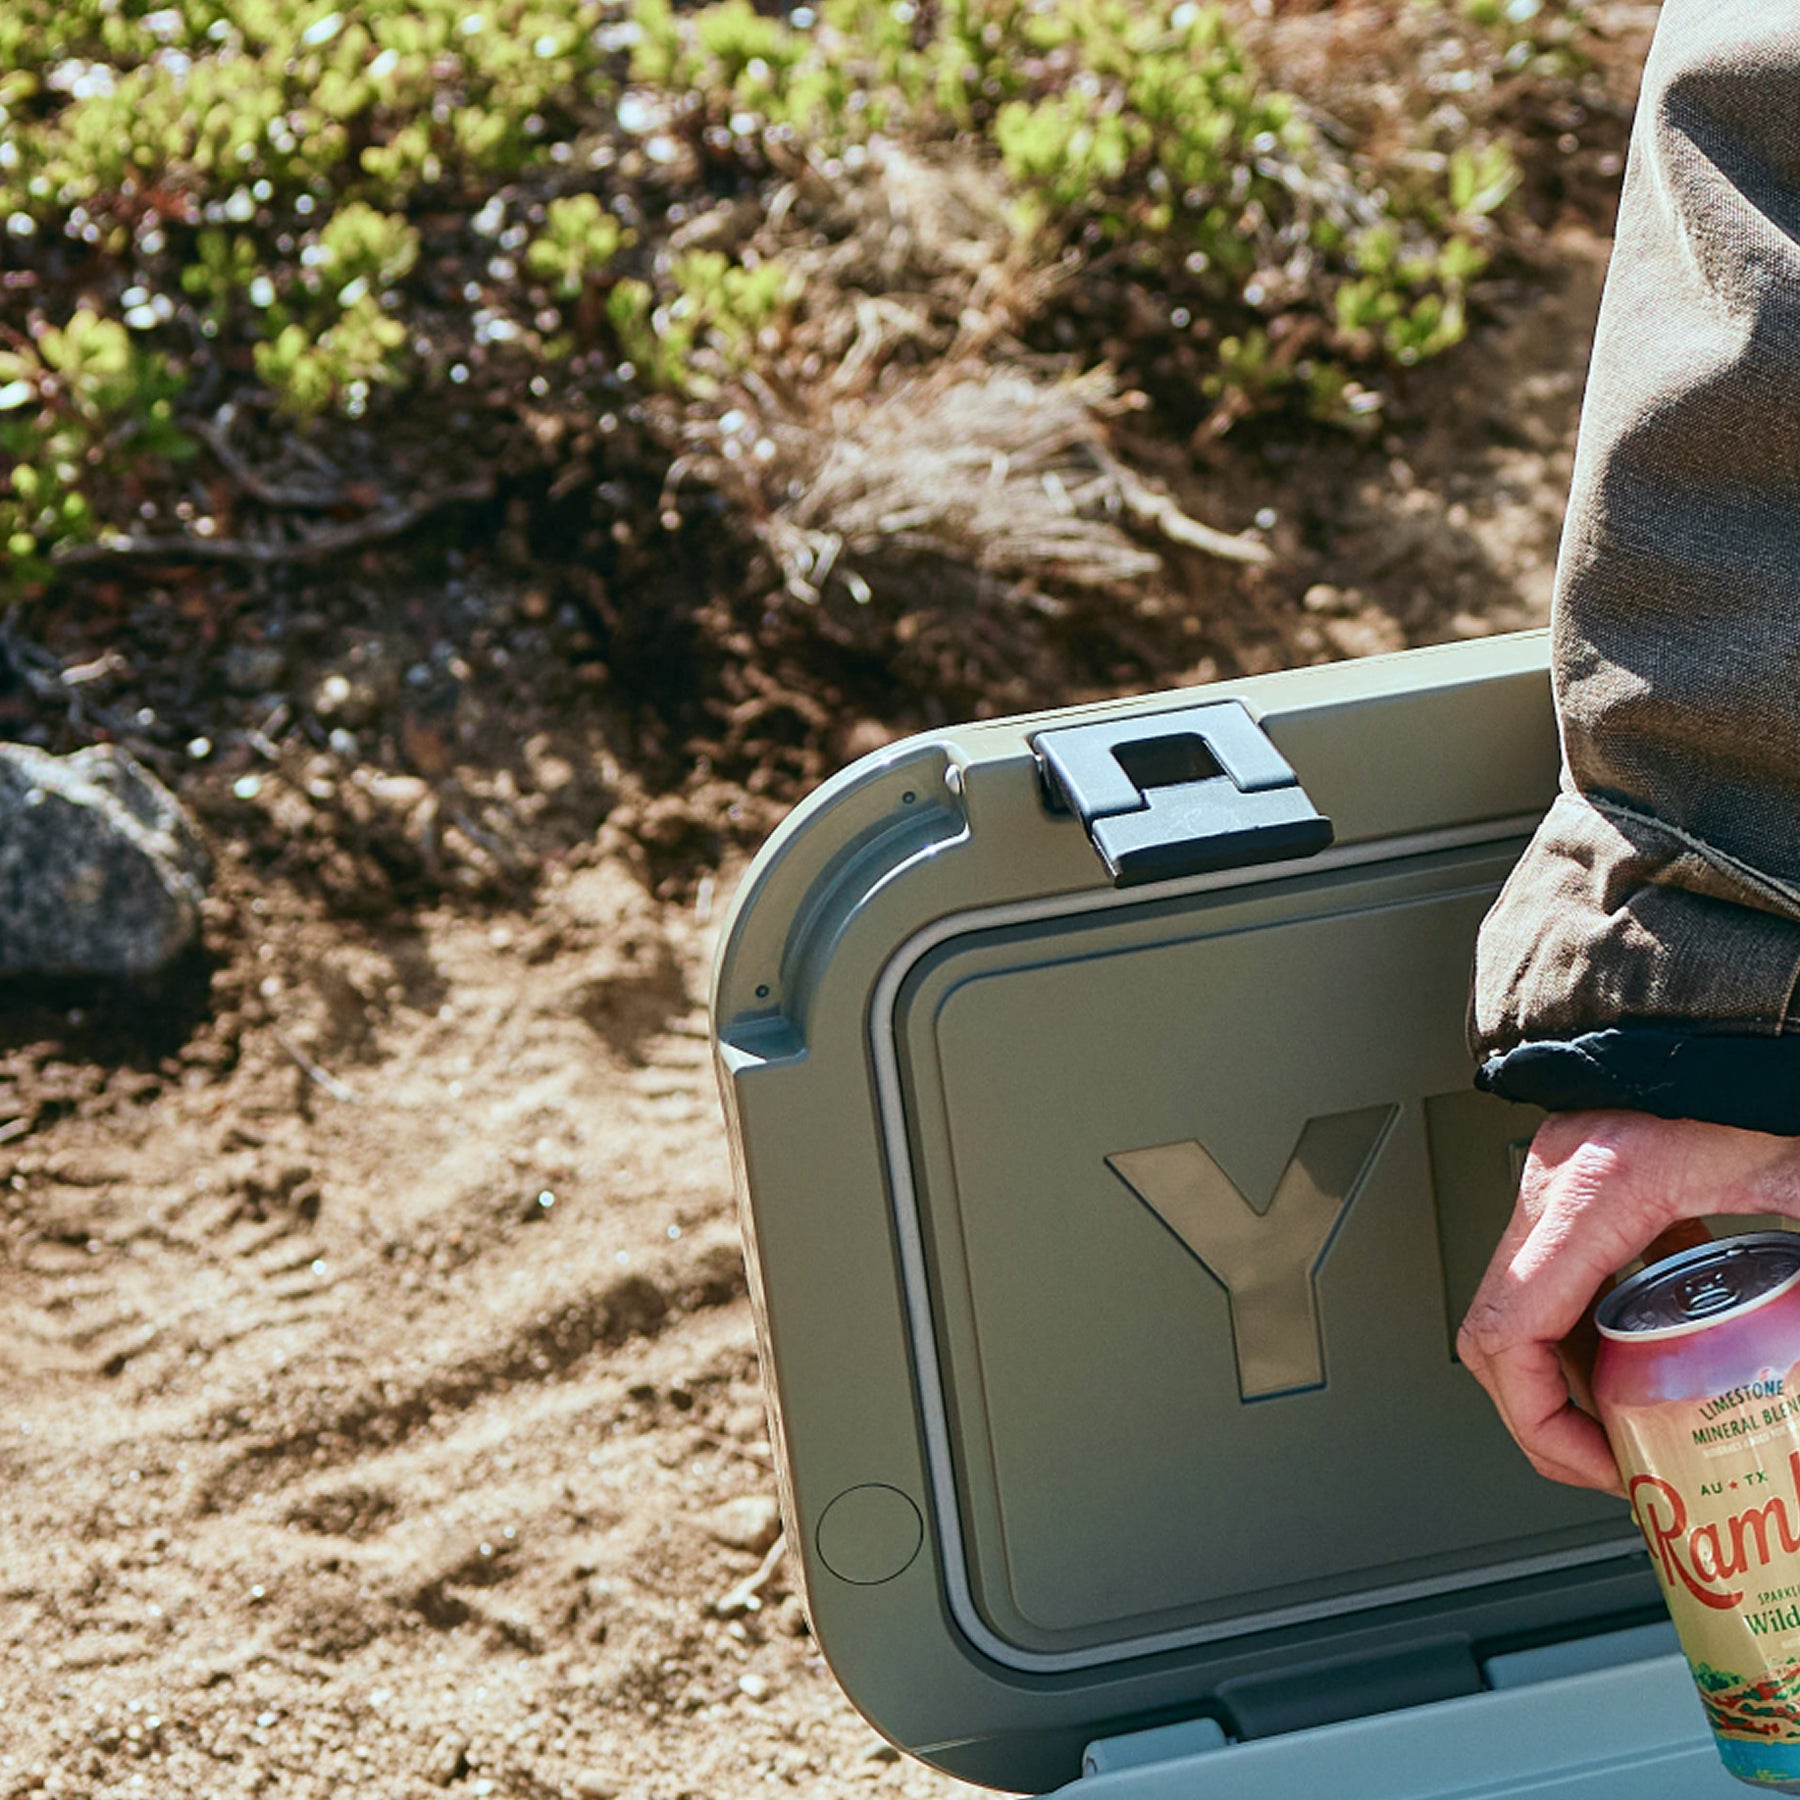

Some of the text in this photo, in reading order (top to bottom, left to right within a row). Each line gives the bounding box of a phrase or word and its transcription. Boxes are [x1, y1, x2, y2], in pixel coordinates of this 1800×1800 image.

[1699, 1380, 1785, 1421] LIMESTONE
[1692, 1415, 1760, 1445] MINERAL
[1701, 1471, 1768, 1496] AU TX
